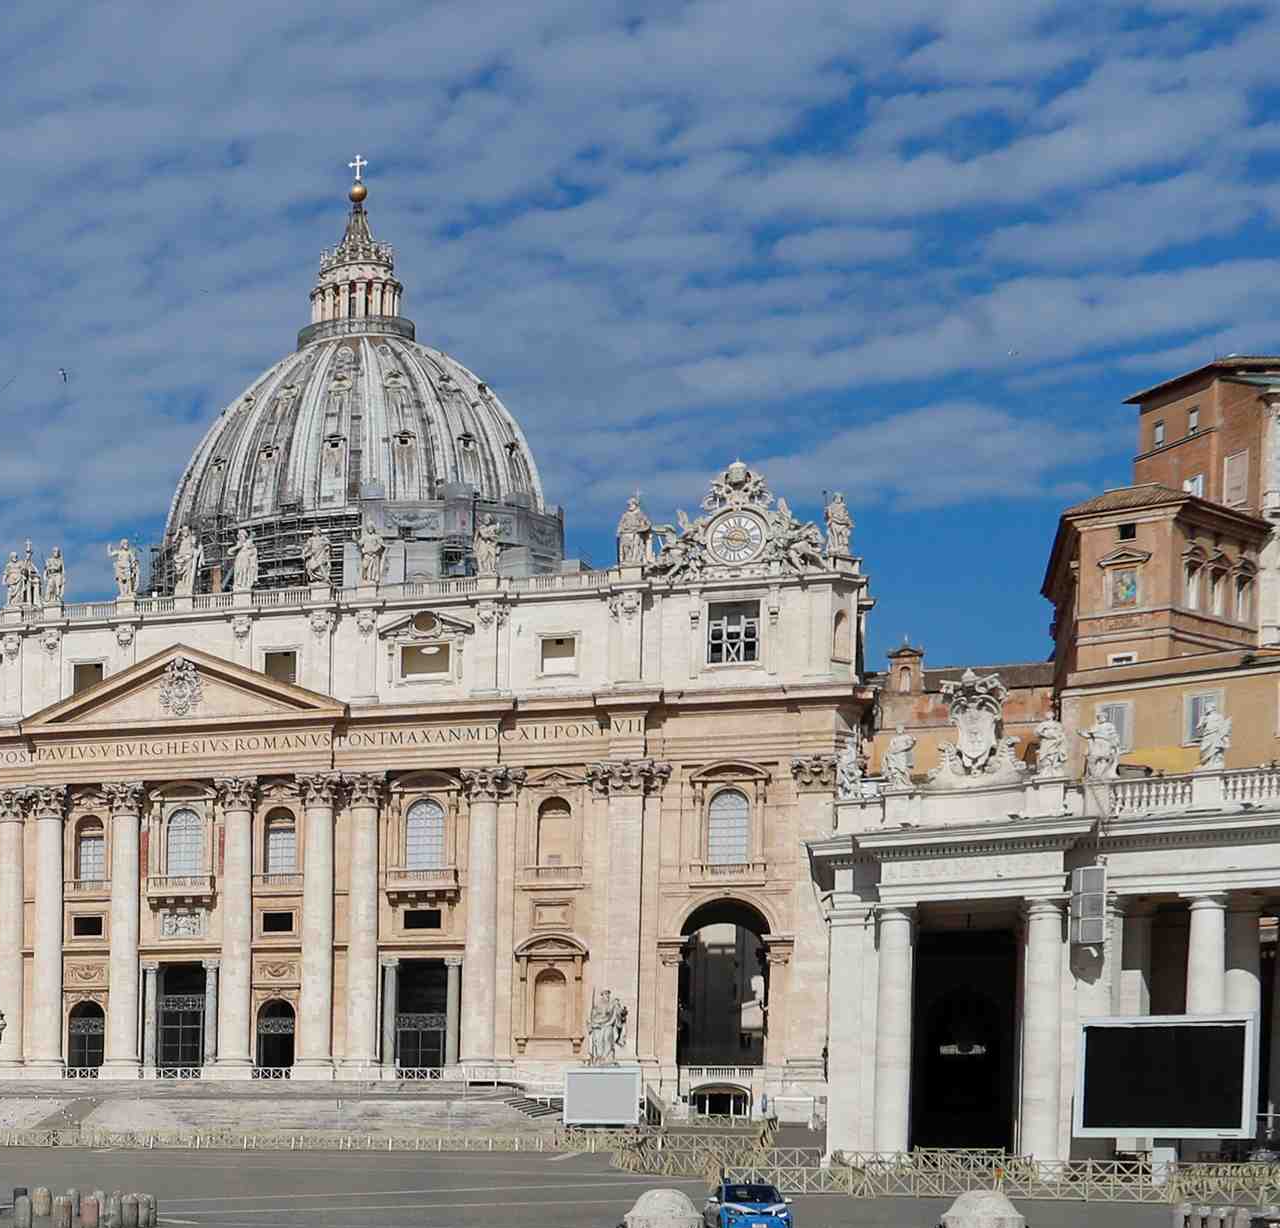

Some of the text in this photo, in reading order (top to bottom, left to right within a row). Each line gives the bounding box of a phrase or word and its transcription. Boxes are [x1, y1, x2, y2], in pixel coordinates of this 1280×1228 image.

[38, 746, 97, 761] PAVLVS
[116, 740, 230, 757] BVRGHESIVS
[235, 734, 331, 751] ROMANVS
